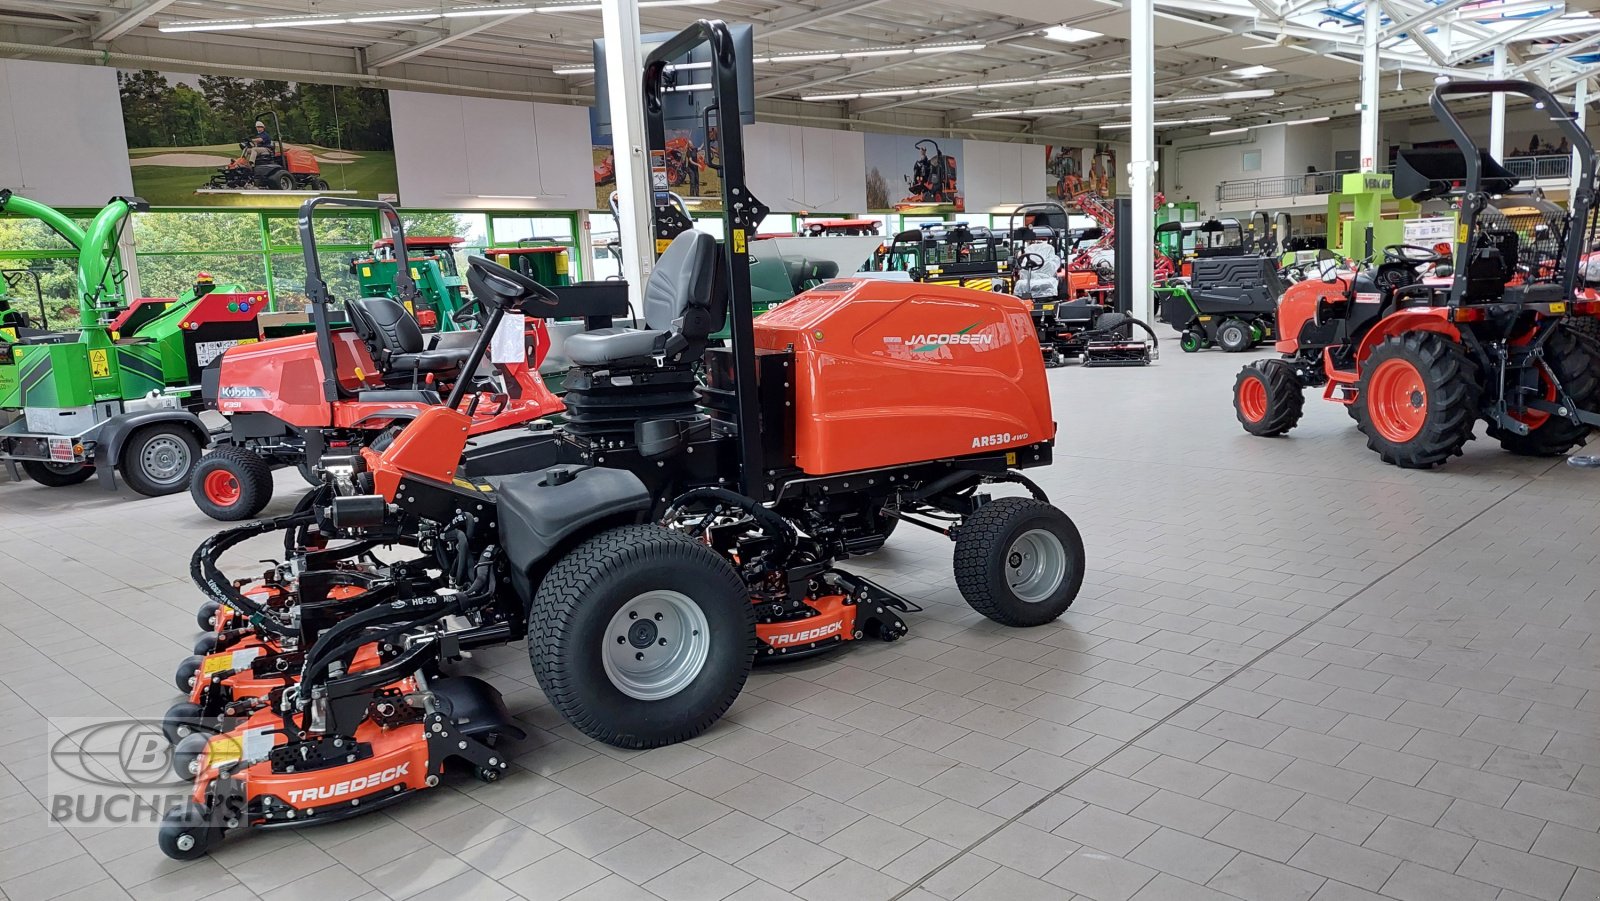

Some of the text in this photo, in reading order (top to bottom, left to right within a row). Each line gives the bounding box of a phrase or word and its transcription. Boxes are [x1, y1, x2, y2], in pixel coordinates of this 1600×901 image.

[904, 333, 993, 346] JACOBSEN
[222, 387, 257, 397] Kubota
[971, 433, 1029, 448] AR530 4WD
[768, 620, 843, 645] TRUEDECK
[287, 761, 411, 803] TRUEDECK
